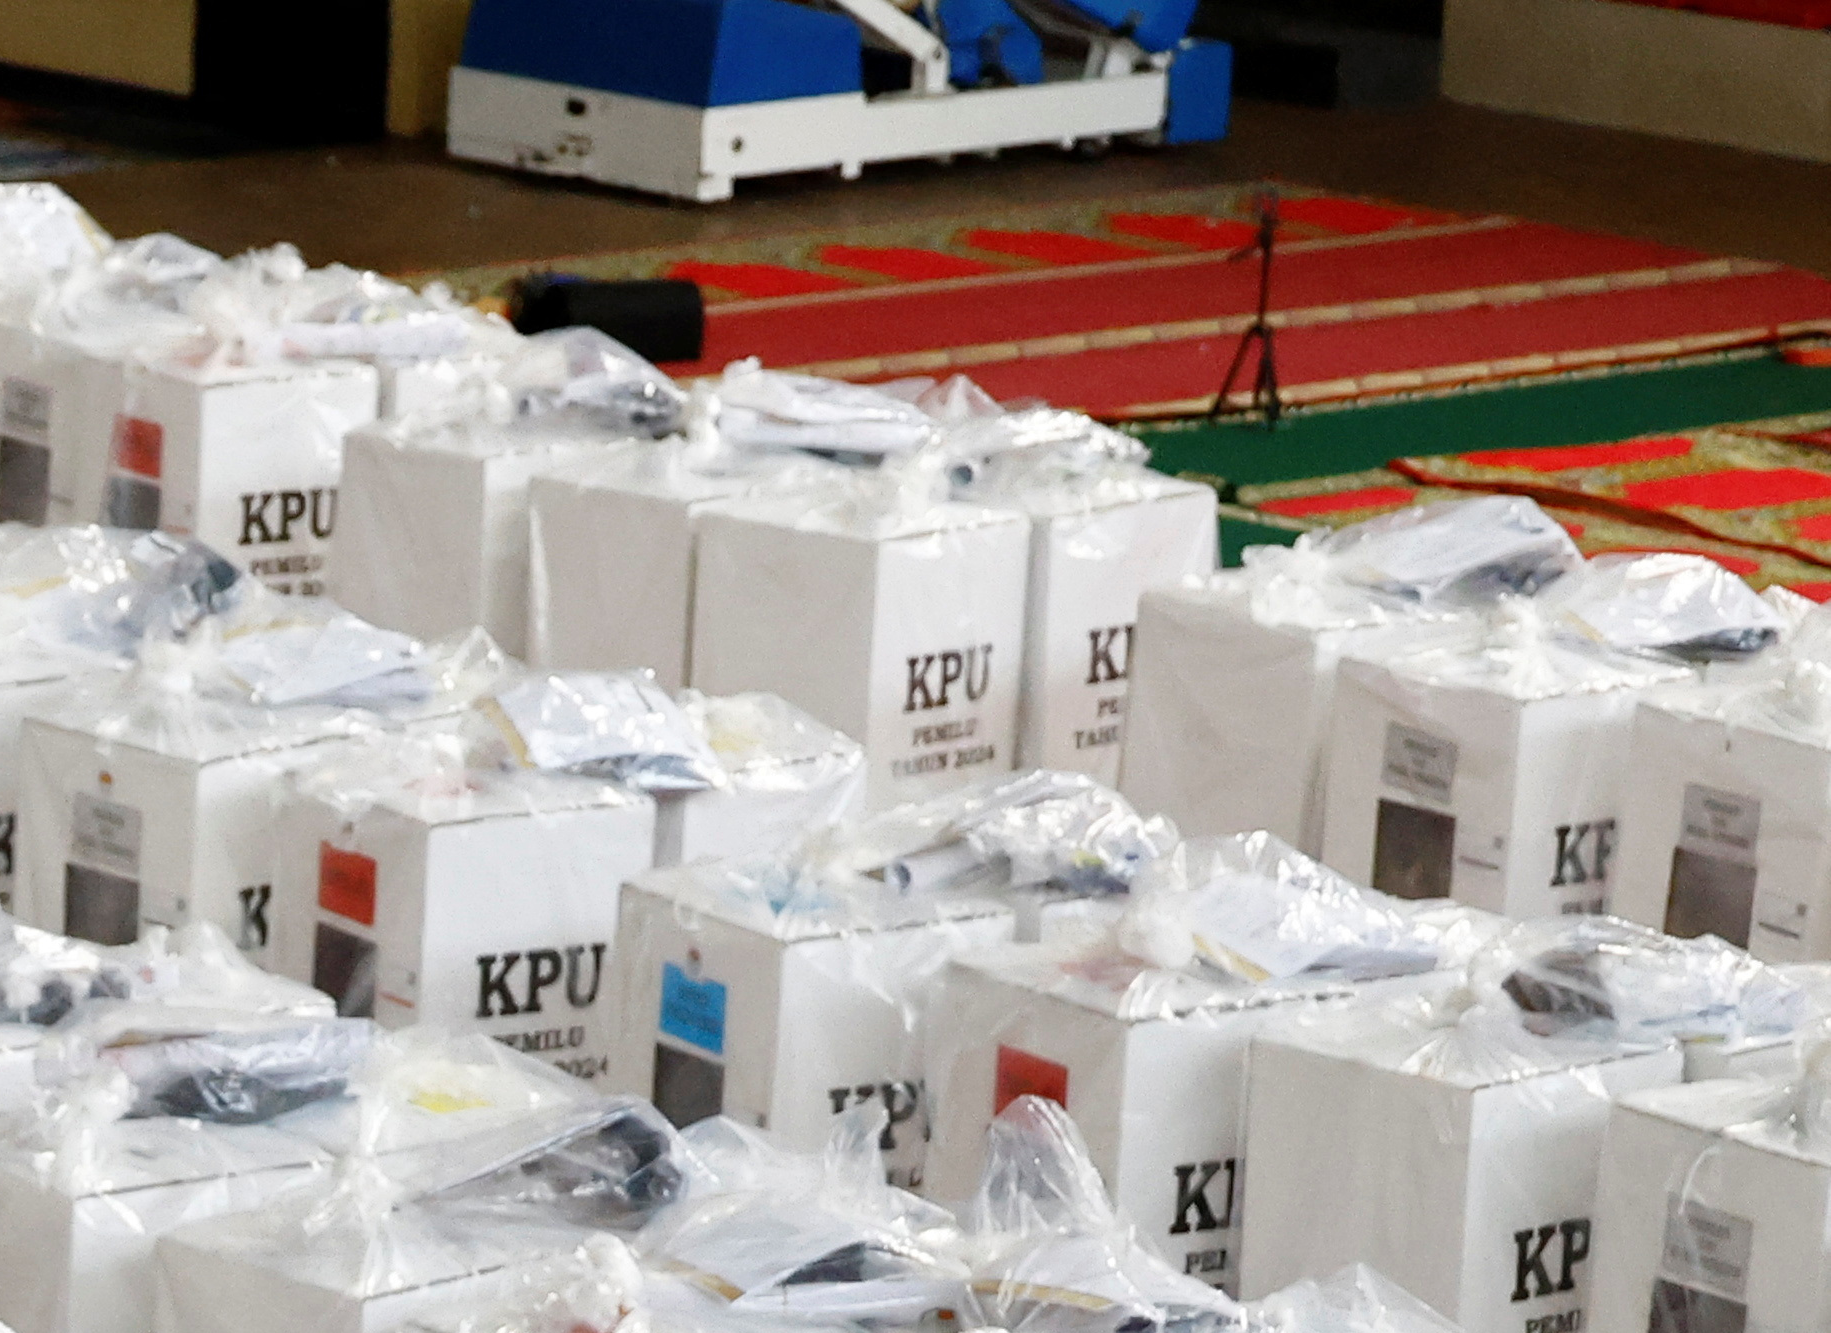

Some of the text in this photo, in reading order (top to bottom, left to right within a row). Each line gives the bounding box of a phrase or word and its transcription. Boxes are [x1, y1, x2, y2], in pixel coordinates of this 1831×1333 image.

[237, 487, 337, 546] KPU
[903, 644, 995, 714] KPU
[476, 942, 605, 1019] KPU
[1511, 1217, 1592, 1305] KP
